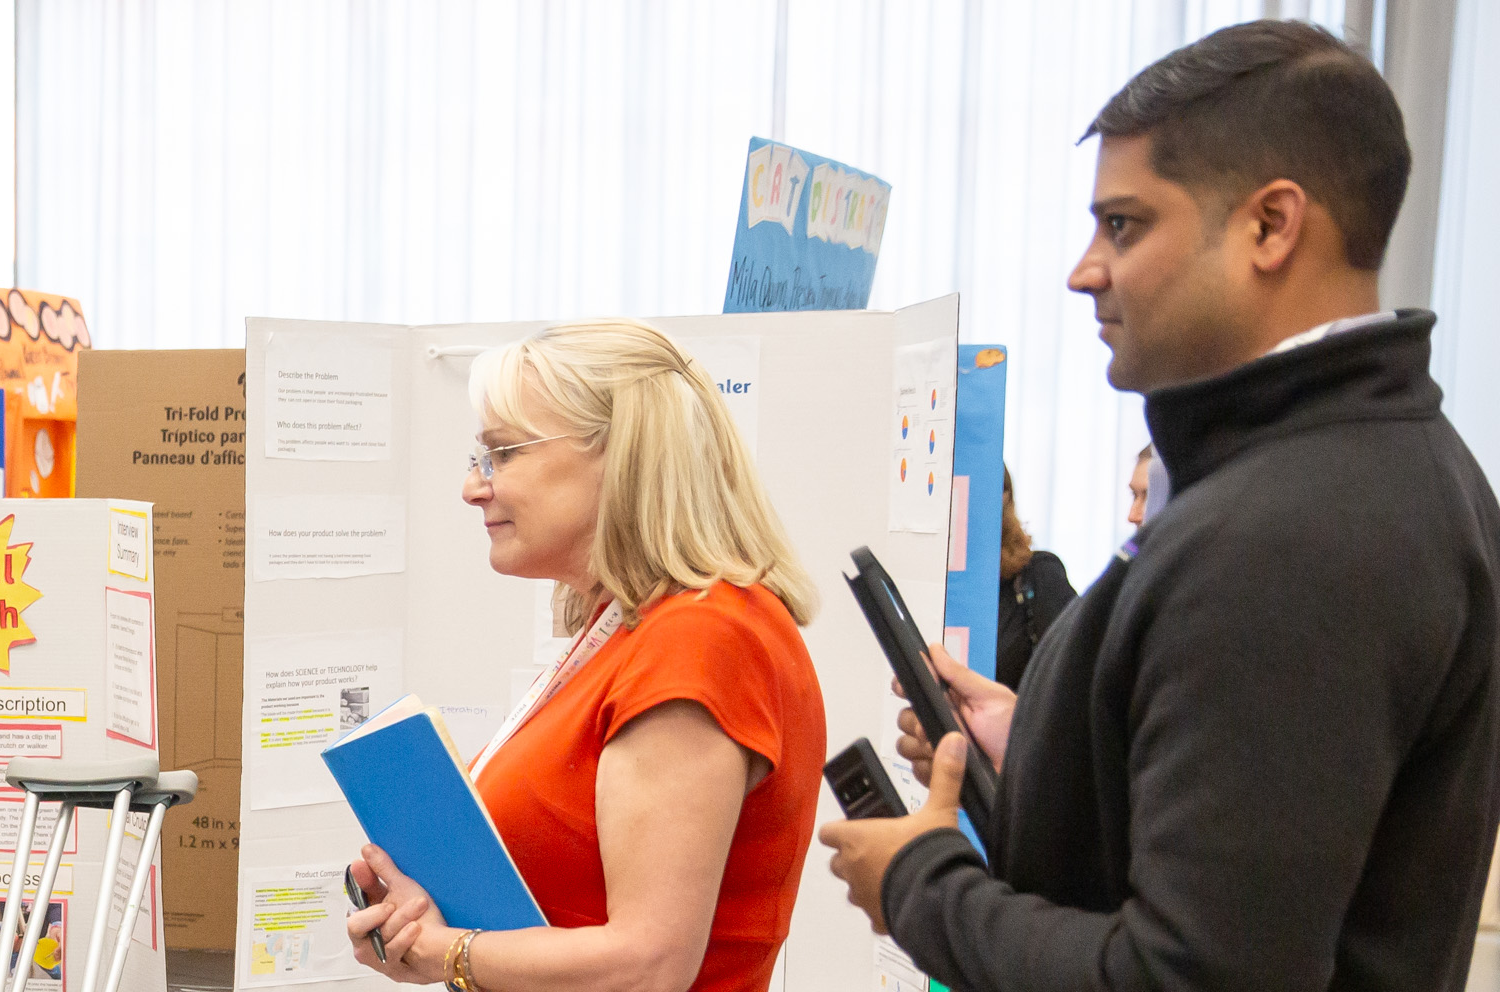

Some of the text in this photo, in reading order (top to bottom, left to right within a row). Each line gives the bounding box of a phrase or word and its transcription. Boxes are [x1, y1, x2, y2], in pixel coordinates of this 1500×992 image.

[753, 163, 800, 217] CAT
[277, 370, 338, 381] Describe the Problem
[716, 379, 752, 393] aler
[164, 406, 219, 421] Tri-Fold
[276, 420, 362, 432] Who does this problem affect?
[161, 428, 245, 447] Tríptico par
[132, 450, 245, 465] Panneau d'affic
[117, 520, 139, 538] Interview
[268, 528, 387, 538] How does your product solve the problem?
[116, 550, 140, 567] Summary
[265, 663, 378, 678] How does SCIENCE or TECHNOLOGY help
[265, 674, 358, 690] explain how your product works?
[31, 732, 43, 741] clip
[192, 816, 236, 830] 48 in x
[179, 835, 227, 849] 1.2 m x
[295, 869, 318, 878] Product
